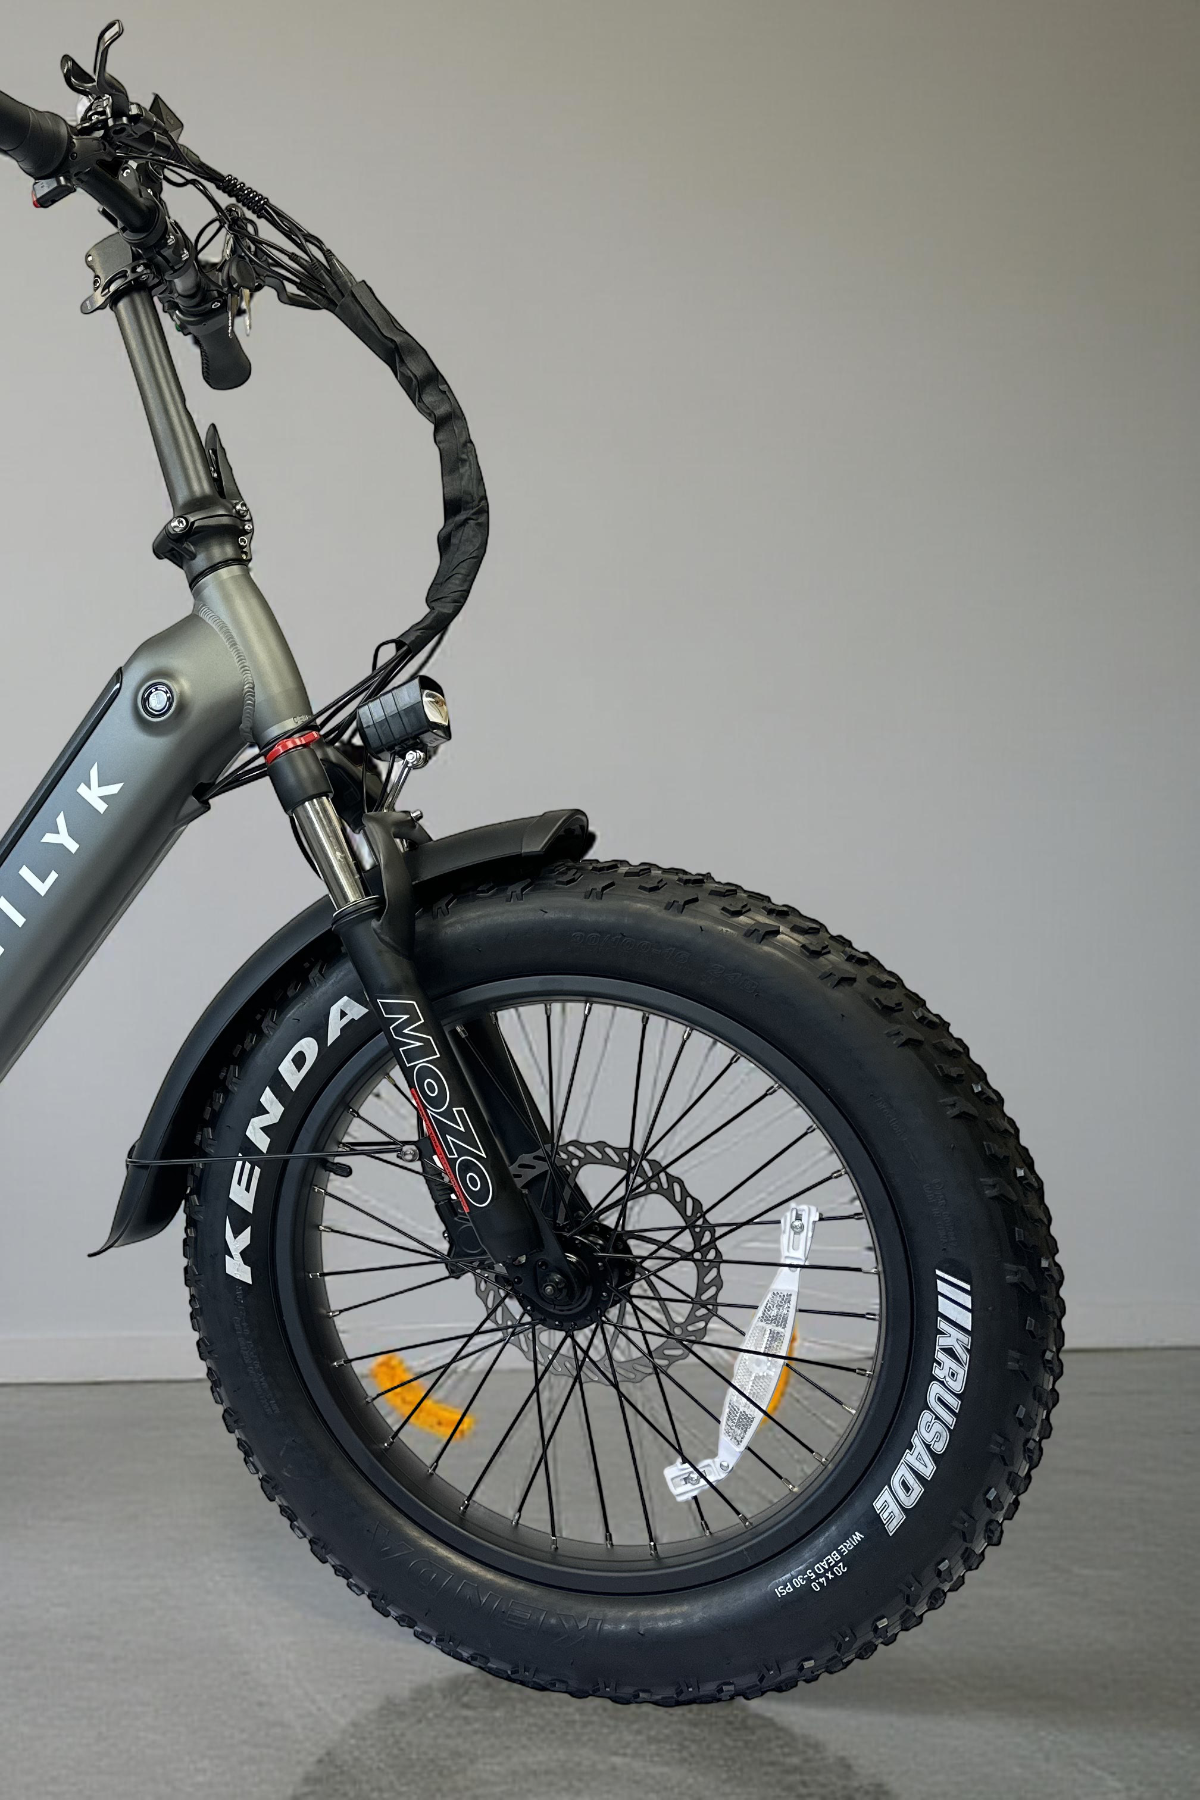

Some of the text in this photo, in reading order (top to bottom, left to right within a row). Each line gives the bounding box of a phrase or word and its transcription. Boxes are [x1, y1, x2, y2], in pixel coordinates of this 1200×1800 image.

[225, 995, 370, 1285] KENDA
[376, 998, 493, 1208] MOZO
[873, 1320, 972, 1536] KRUSADE
[368, 1521, 603, 1649] KENDA
[774, 1531, 864, 1597] WIRE BEAD 5-30 PSI
[811, 1576, 827, 1592] 4.0
[833, 1562, 847, 1575] 20
